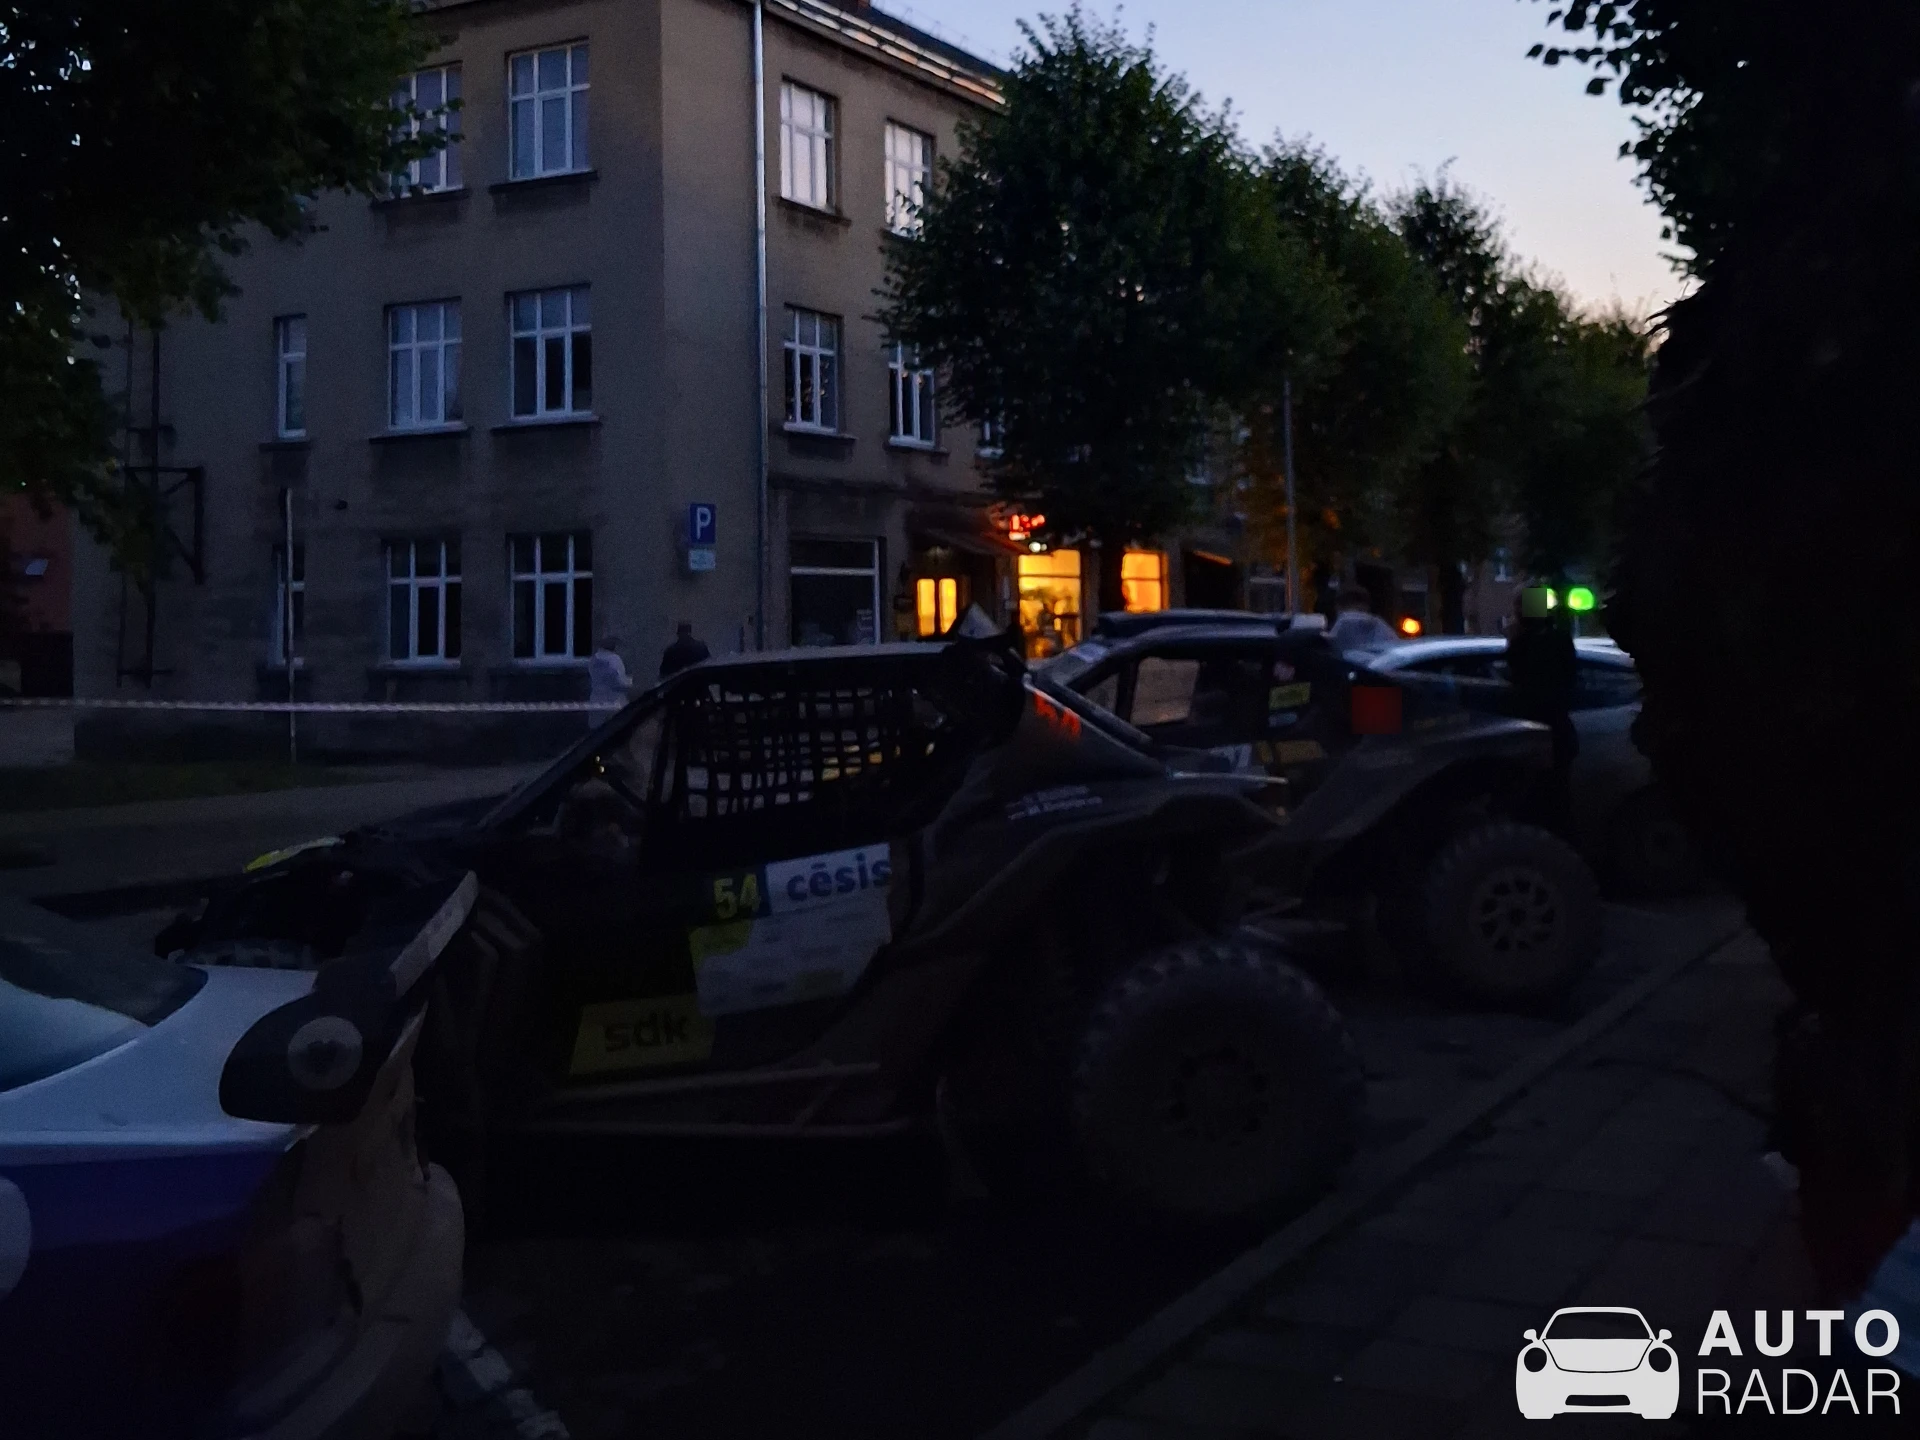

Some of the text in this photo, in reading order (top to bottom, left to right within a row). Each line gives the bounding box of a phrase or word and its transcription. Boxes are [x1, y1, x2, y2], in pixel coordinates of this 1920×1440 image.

[696, 506, 712, 540] P
[713, 873, 762, 920] 54
[787, 852, 891, 902] cēsis
[604, 1008, 689, 1053] sdk
